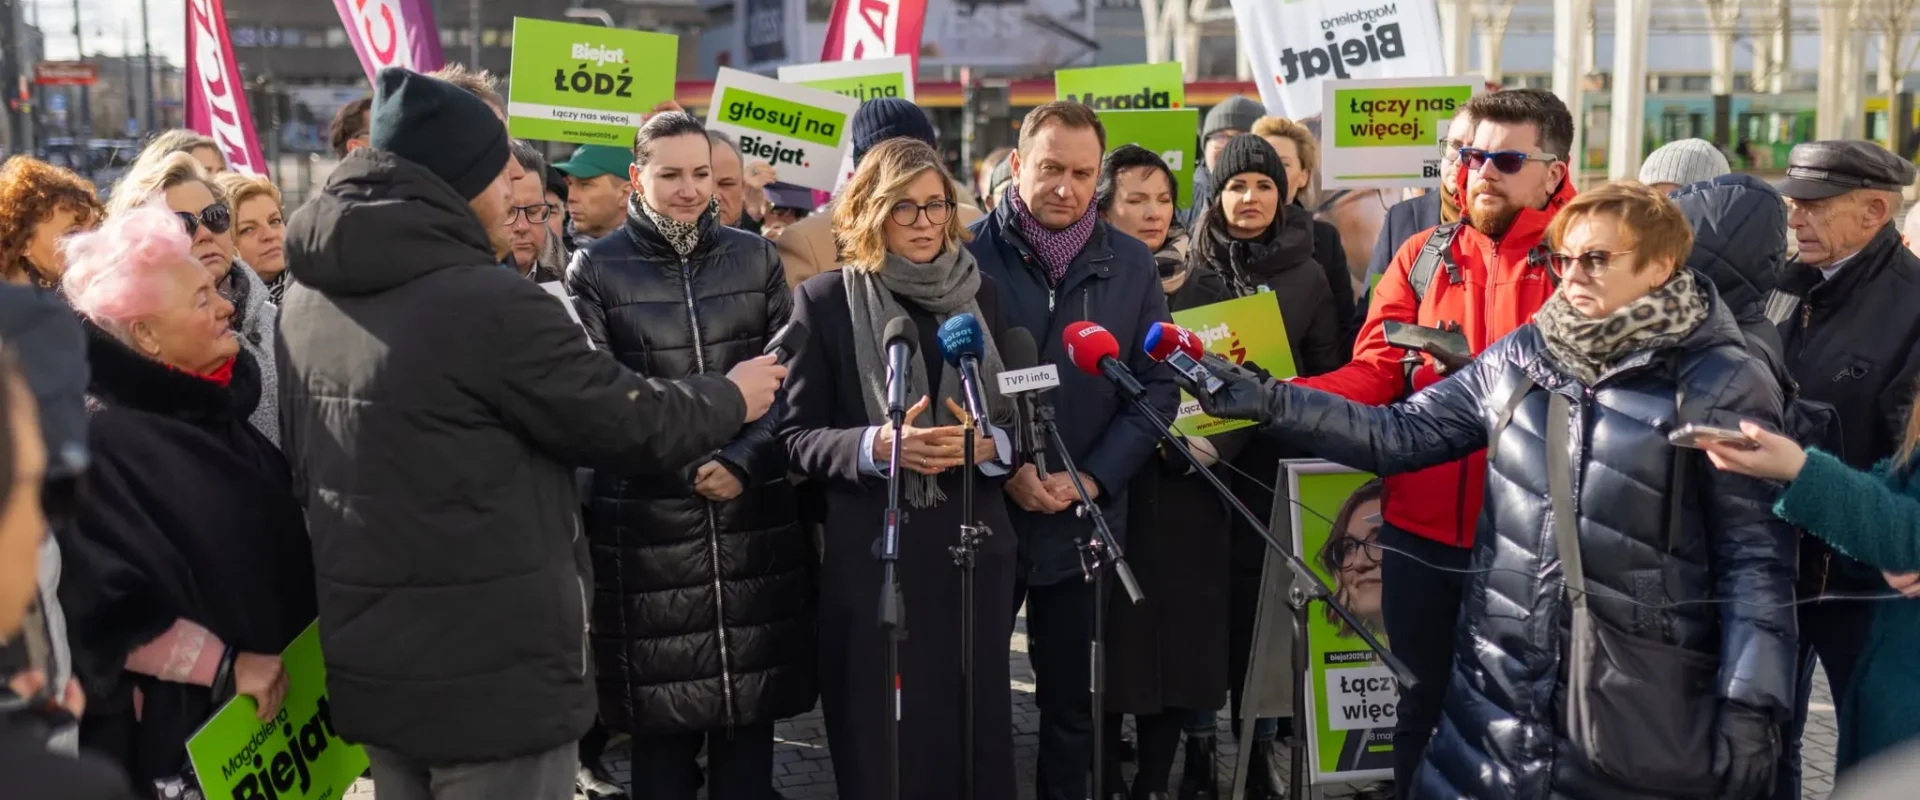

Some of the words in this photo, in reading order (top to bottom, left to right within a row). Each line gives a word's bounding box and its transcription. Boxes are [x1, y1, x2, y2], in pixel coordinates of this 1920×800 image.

[571, 42, 630, 66] Biejat.
[554, 62, 634, 98] ŁÓDŹ
[870, 85, 898, 99] na
[552, 108, 579, 121] Łączy
[580, 112, 598, 121] nas
[600, 114, 631, 126] więcej.
[1350, 97, 1411, 116] Łączy
[1415, 97, 1456, 112] nas
[728, 101, 802, 134] głosuj
[804, 117, 836, 137] na
[1350, 118, 1424, 141] więcej.
[739, 135, 810, 168] Biejat.
[947, 336, 972, 353] news
[1004, 375, 1024, 386] TVP
[1179, 404, 1201, 415] Łącz
[1340, 675, 1399, 697] Łączy
[221, 707, 289, 782] Magdalena
